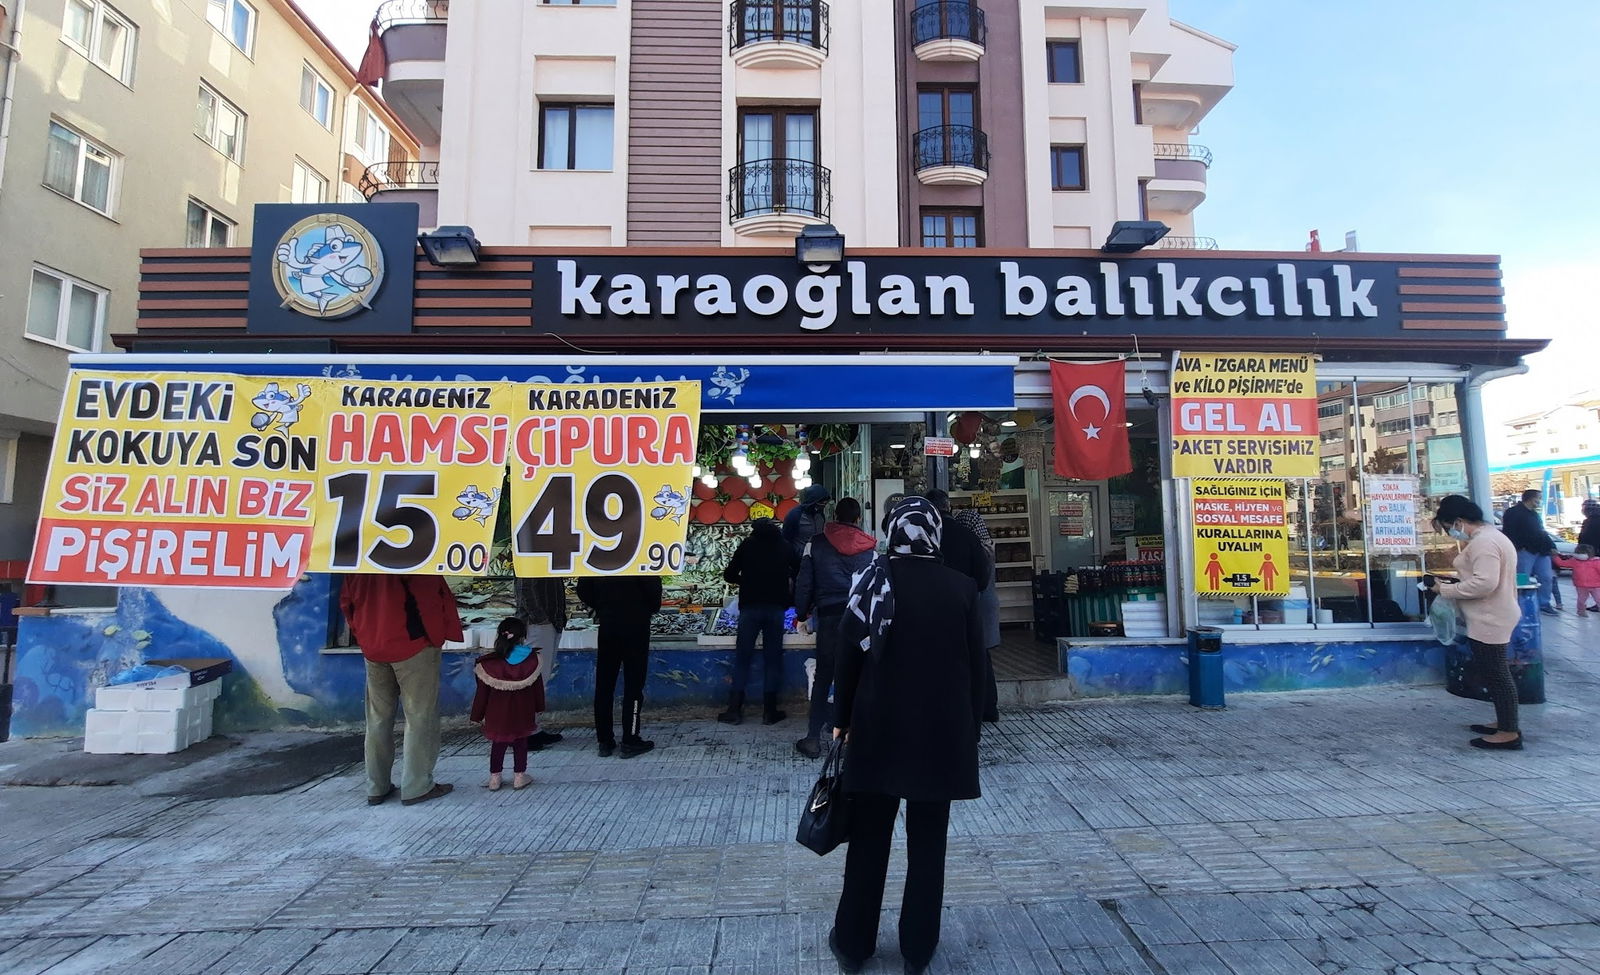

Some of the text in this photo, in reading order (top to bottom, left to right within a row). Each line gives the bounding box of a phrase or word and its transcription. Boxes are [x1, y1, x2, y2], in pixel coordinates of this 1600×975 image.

[557, 260, 1378, 330] karaoğlan balıkcılık
[1214, 358, 1266, 372] IZGARA
[1269, 356, 1308, 373] MENÜ
[1174, 380, 1191, 393] ve
[1194, 375, 1225, 393] KİLO
[1181, 402, 1302, 432] GEL AL
[67, 430, 318, 471] KOKUYA SON
[1214, 458, 1273, 474] VARDIR
[134, 477, 228, 516] ALIN
[1195, 485, 1282, 498] SAĞLIĞINIZ İÇİN
[1196, 503, 1233, 512] MASKE,
[1235, 502, 1269, 512] HİJYEN
[1196, 514, 1283, 524] SOSYAL MESAFE
[1197, 528, 1283, 539] KURALLARINA
[1218, 542, 1263, 552] UYALIM
[1236, 574, 1247, 582] 1.5
